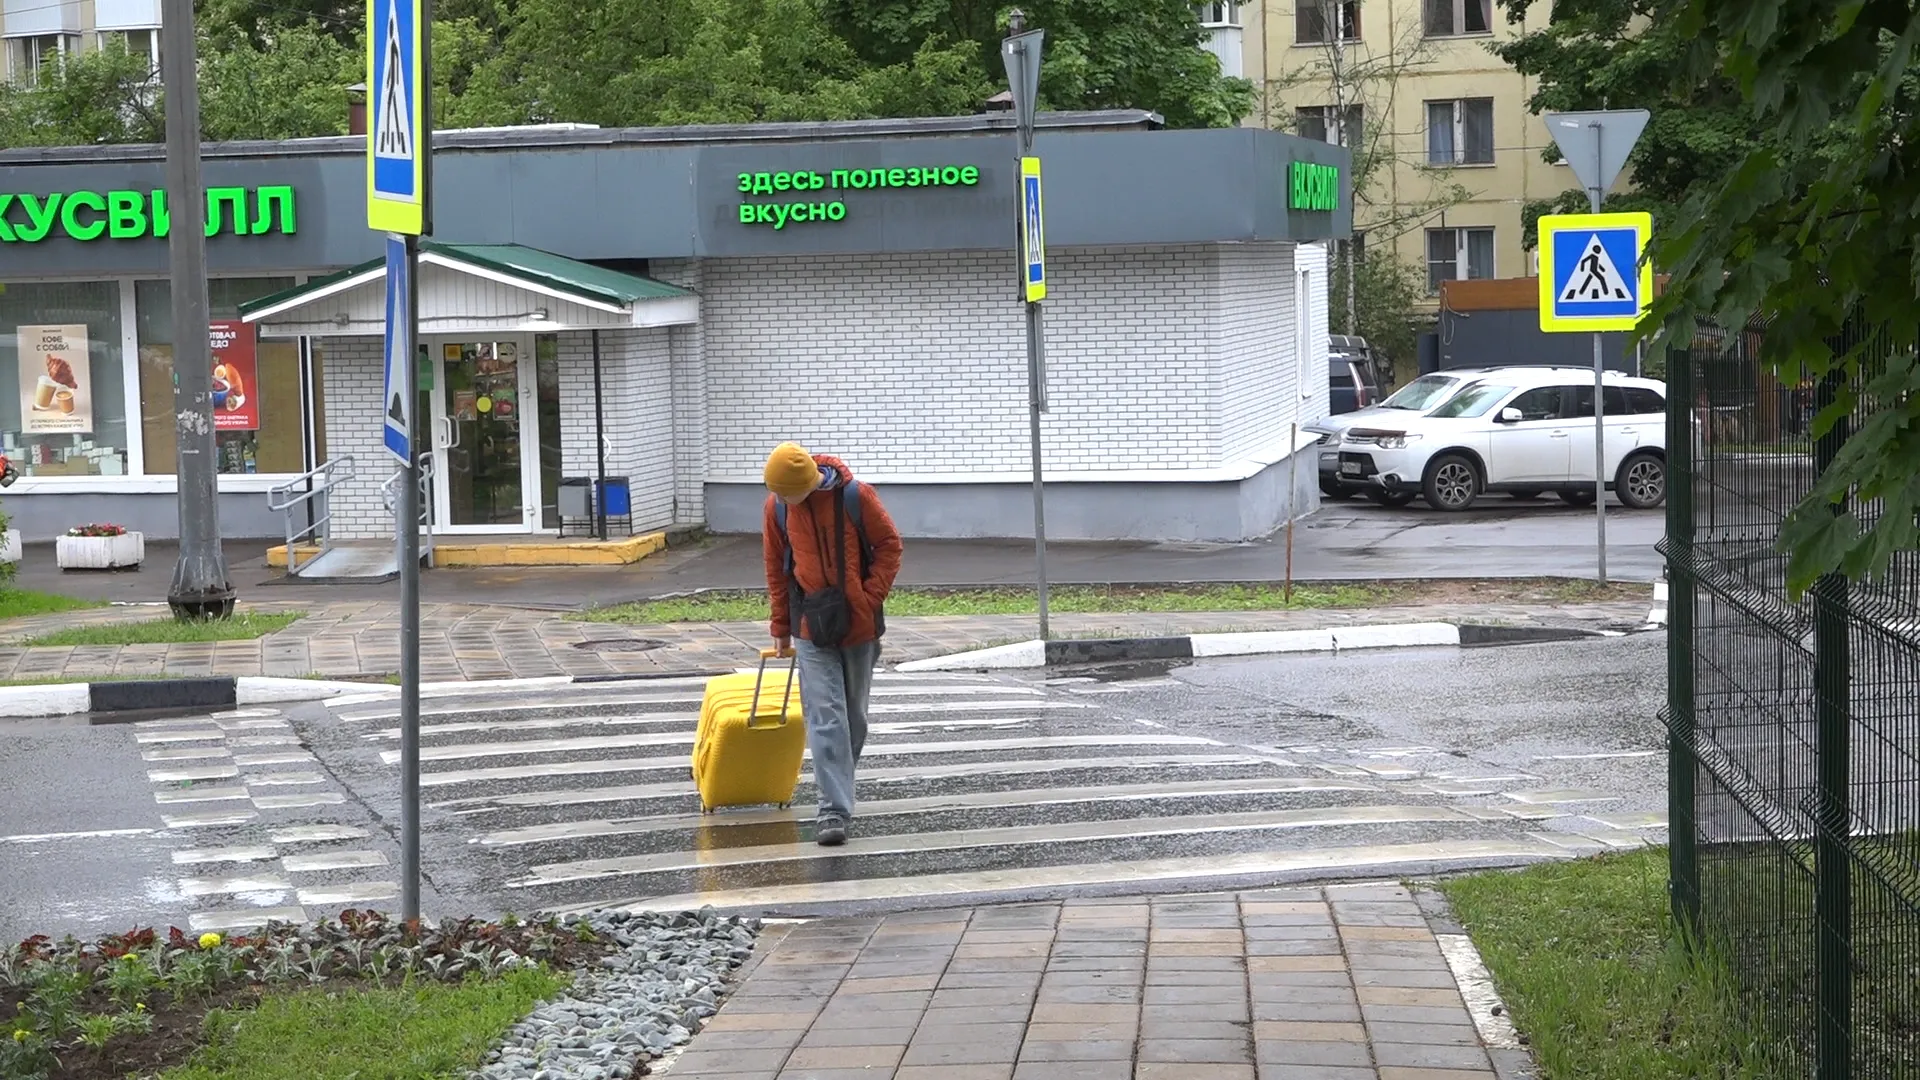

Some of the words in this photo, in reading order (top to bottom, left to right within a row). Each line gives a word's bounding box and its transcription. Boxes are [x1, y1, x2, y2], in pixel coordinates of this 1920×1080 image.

[737, 170, 825, 196] здесь
[831, 164, 979, 189] полезное
[1289, 161, 1339, 212] ВКУСВИЛЛ
[739, 201, 847, 230] вкусно
[42, 342, 70, 352] СОБОЙ
